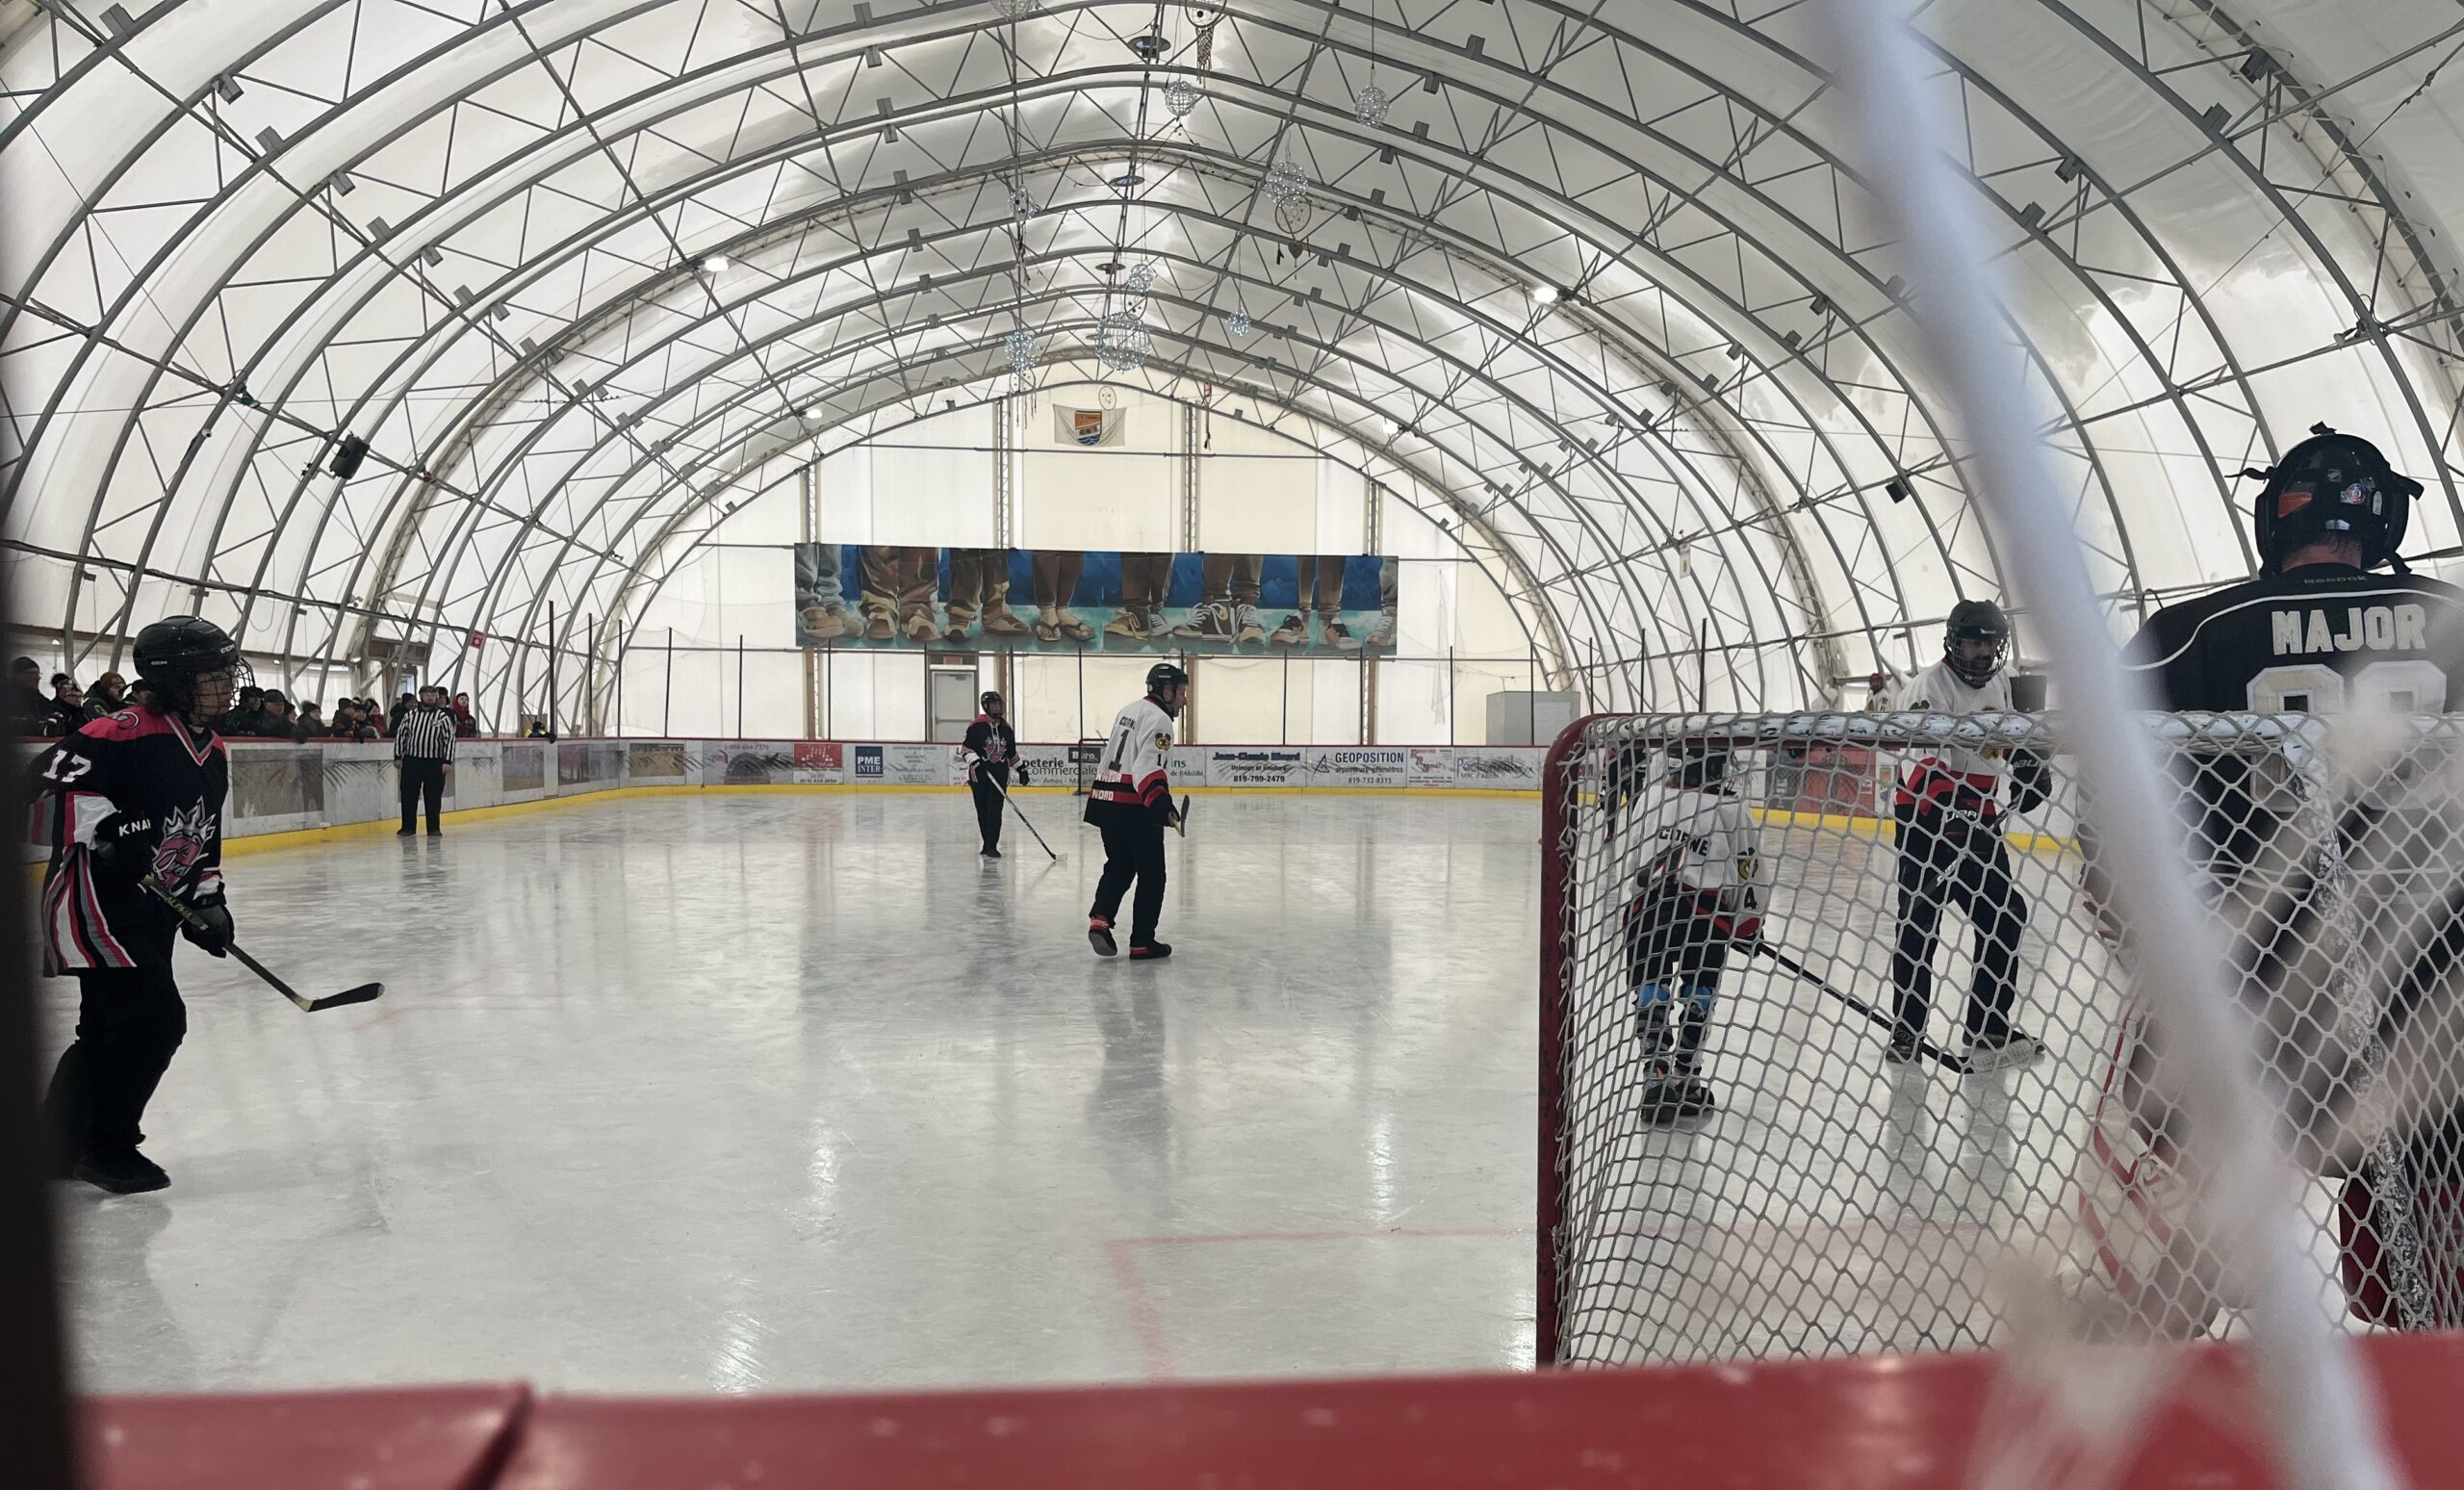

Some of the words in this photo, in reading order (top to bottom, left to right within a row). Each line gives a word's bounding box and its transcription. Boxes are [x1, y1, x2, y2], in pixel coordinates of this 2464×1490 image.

[2272, 604, 2426, 655] MAJOR
[220, 643, 235, 654] CCM
[858, 757, 881, 765] PME
[1335, 752, 1403, 762] GEOPOSITION
[1023, 758, 1064, 769] peterie
[1027, 765, 1098, 776] commercale
[1743, 886, 1757, 910] 4
